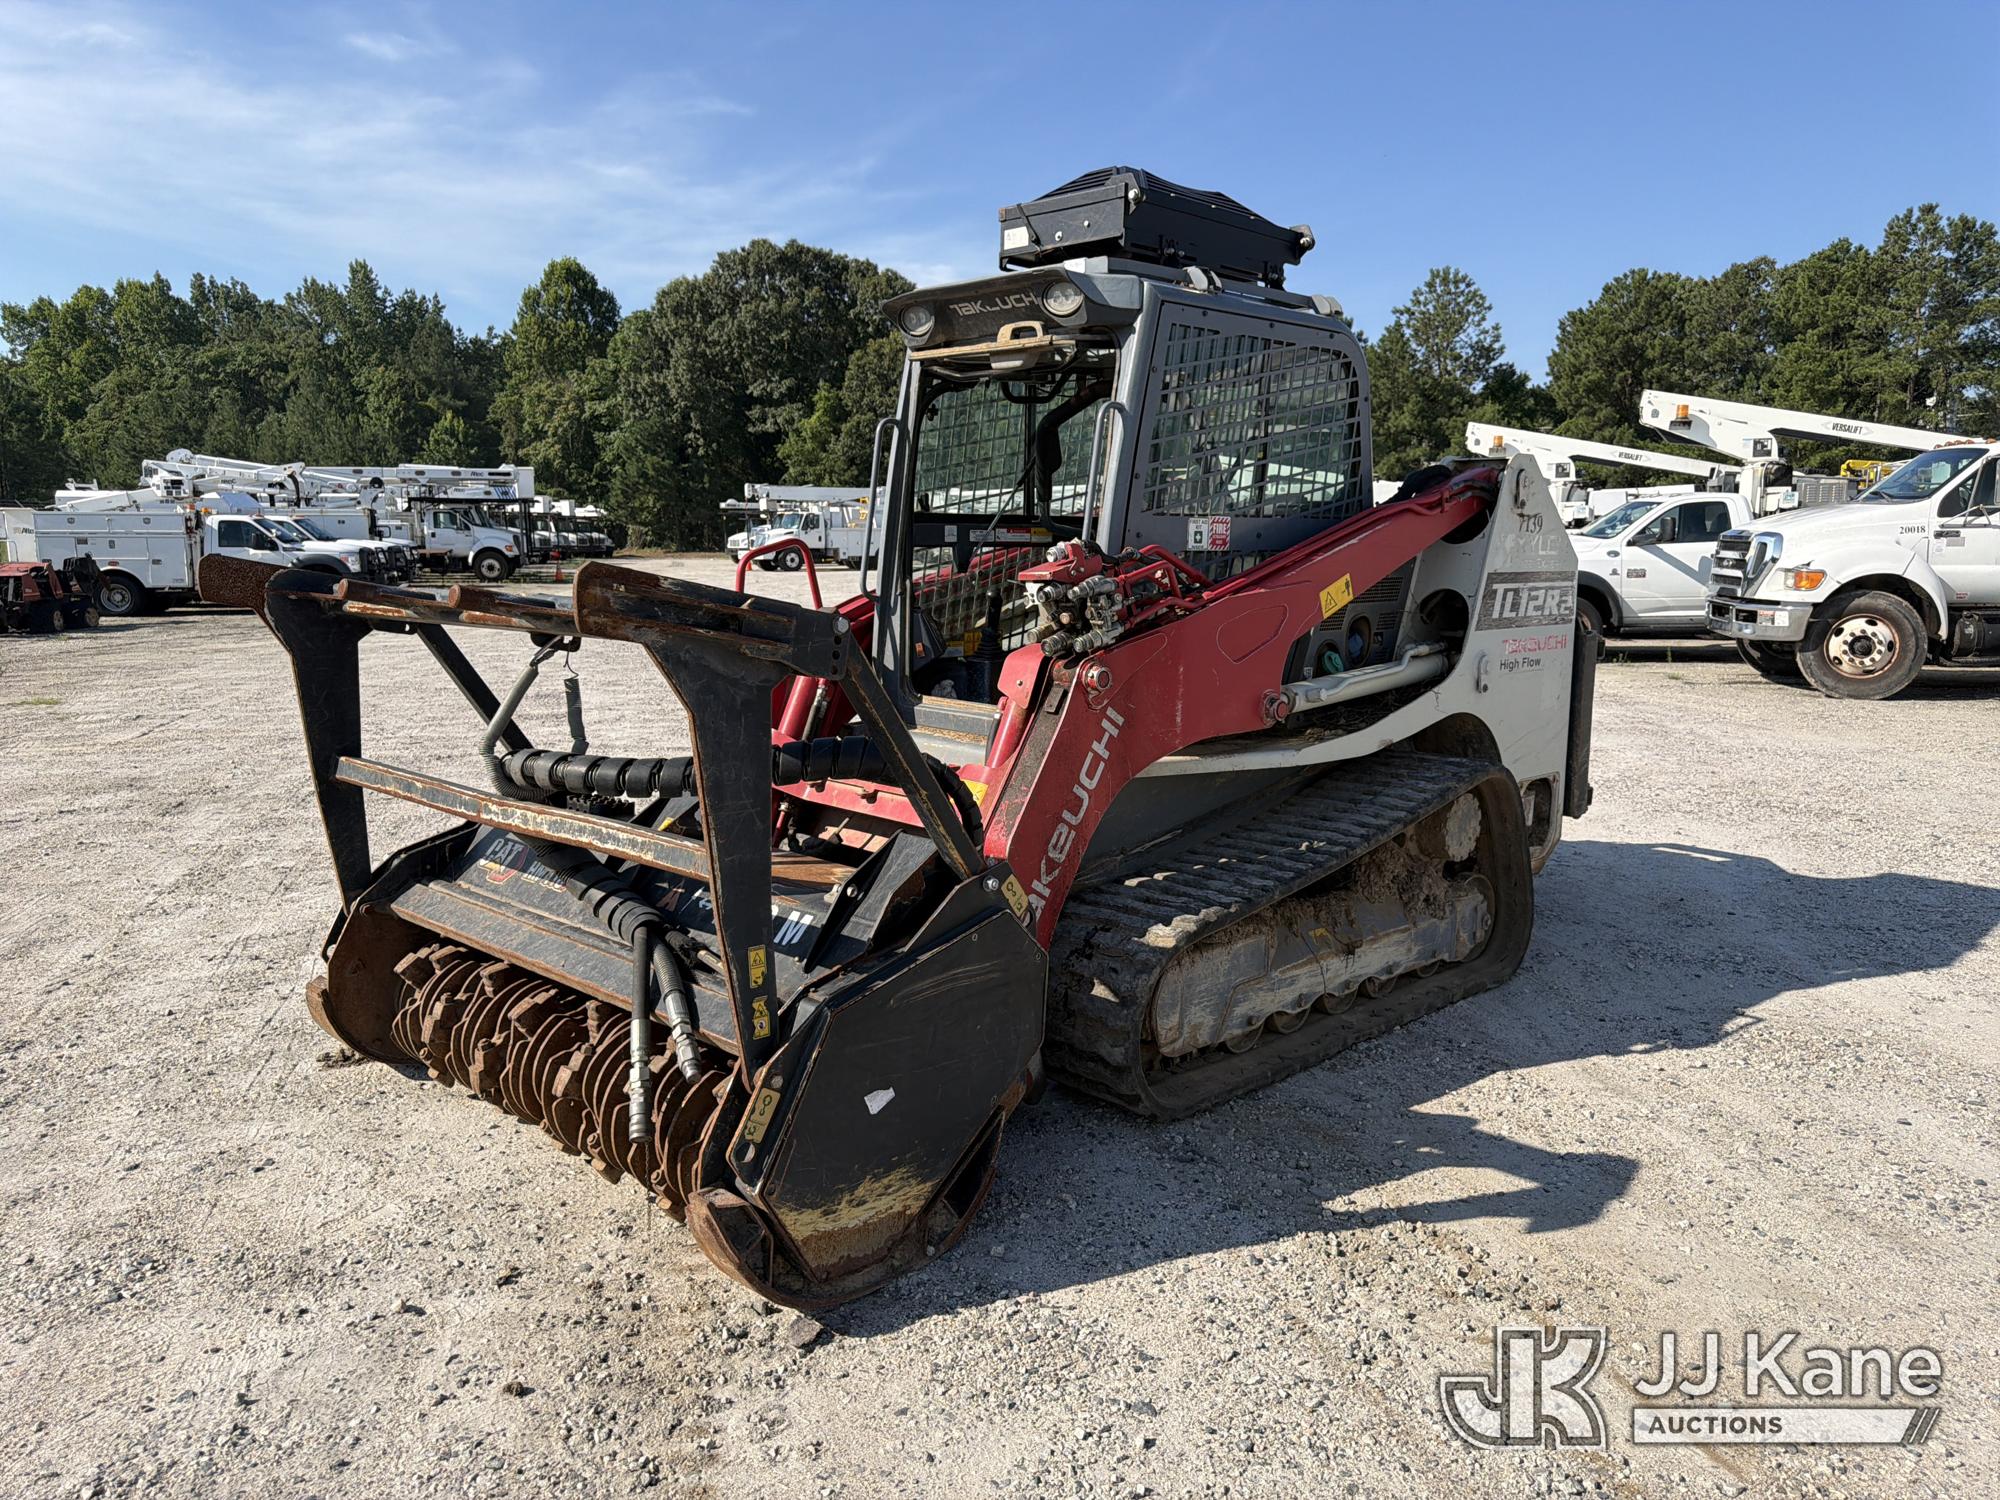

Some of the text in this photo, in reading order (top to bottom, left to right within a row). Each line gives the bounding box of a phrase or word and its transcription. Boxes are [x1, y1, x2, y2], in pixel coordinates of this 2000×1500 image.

[1832, 422, 1863, 435] VERSALIFT
[1212, 523, 1228, 535] FIRE
[1518, 512, 1543, 534] 7139
[1899, 525, 1926, 535] 20018
[1500, 656, 1542, 673] High Flow
[1020, 706, 1125, 928] AKEUCHI
[484, 838, 524, 873] CAT
